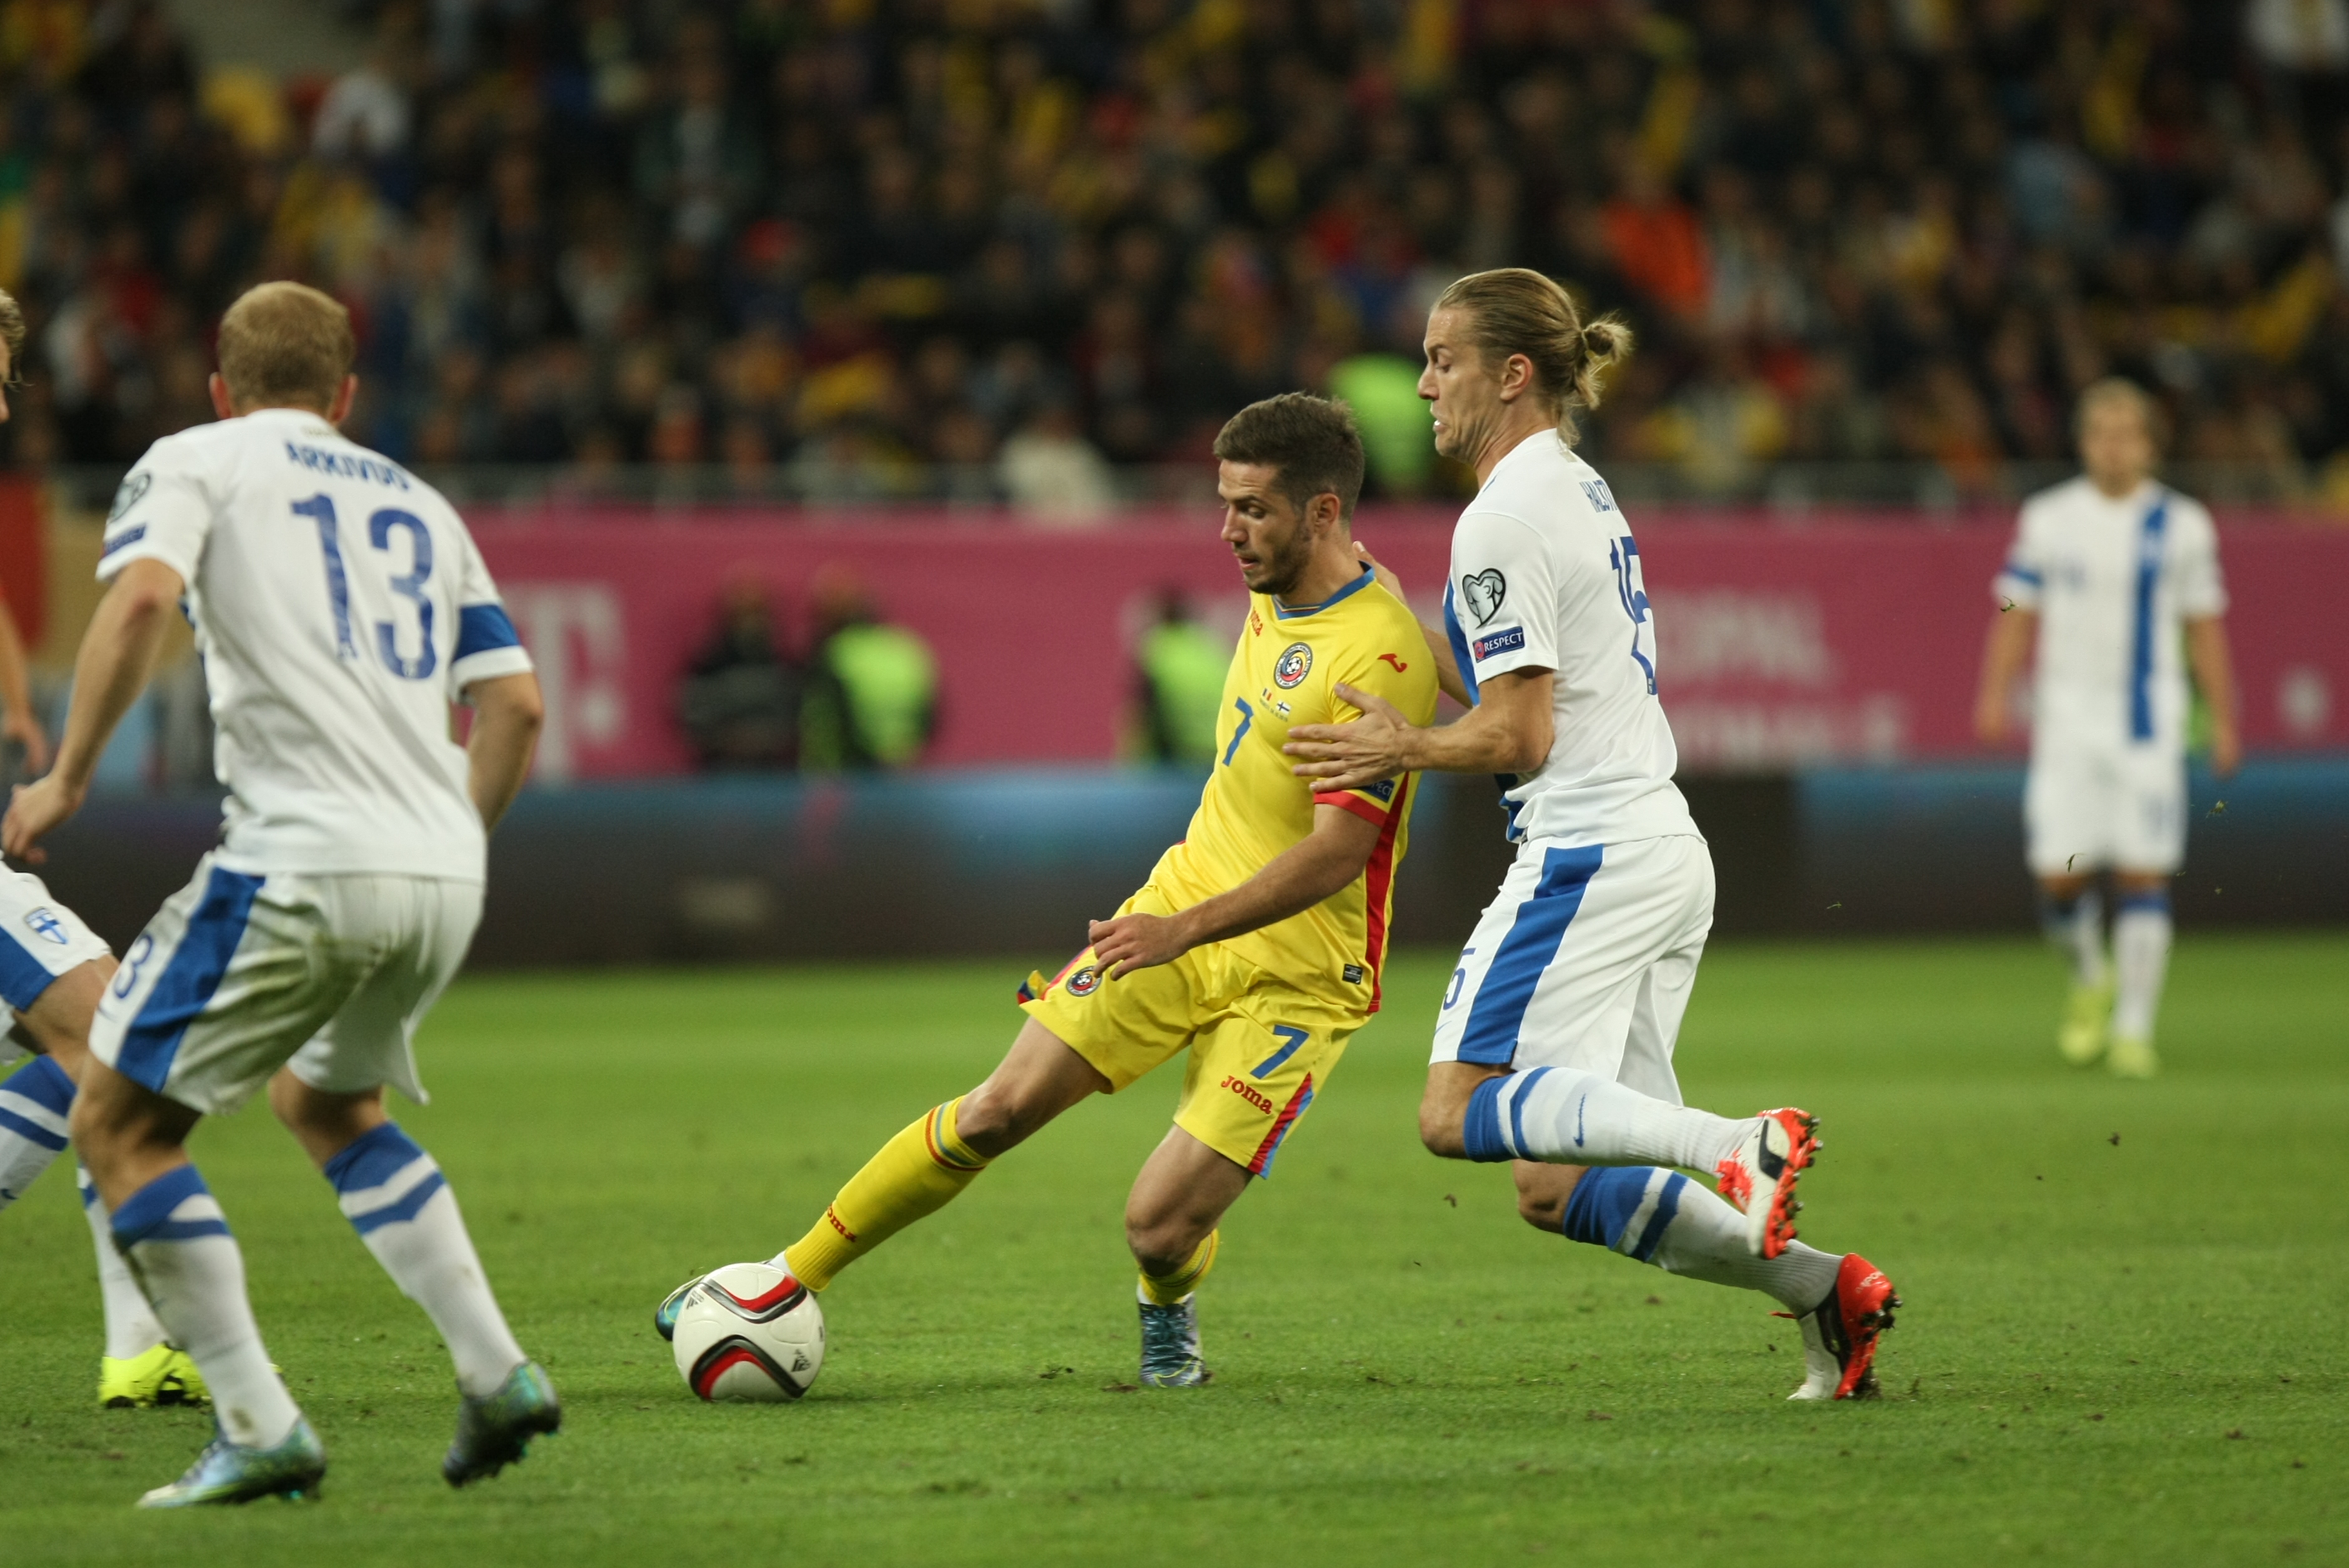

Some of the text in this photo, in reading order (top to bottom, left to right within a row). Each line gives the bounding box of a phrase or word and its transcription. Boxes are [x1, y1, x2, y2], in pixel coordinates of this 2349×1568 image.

[290, 494, 436, 680] 13
[1484, 632, 1523, 652] RESPECT
[1222, 696, 1255, 767] 7
[1249, 1023, 1310, 1080] 7
